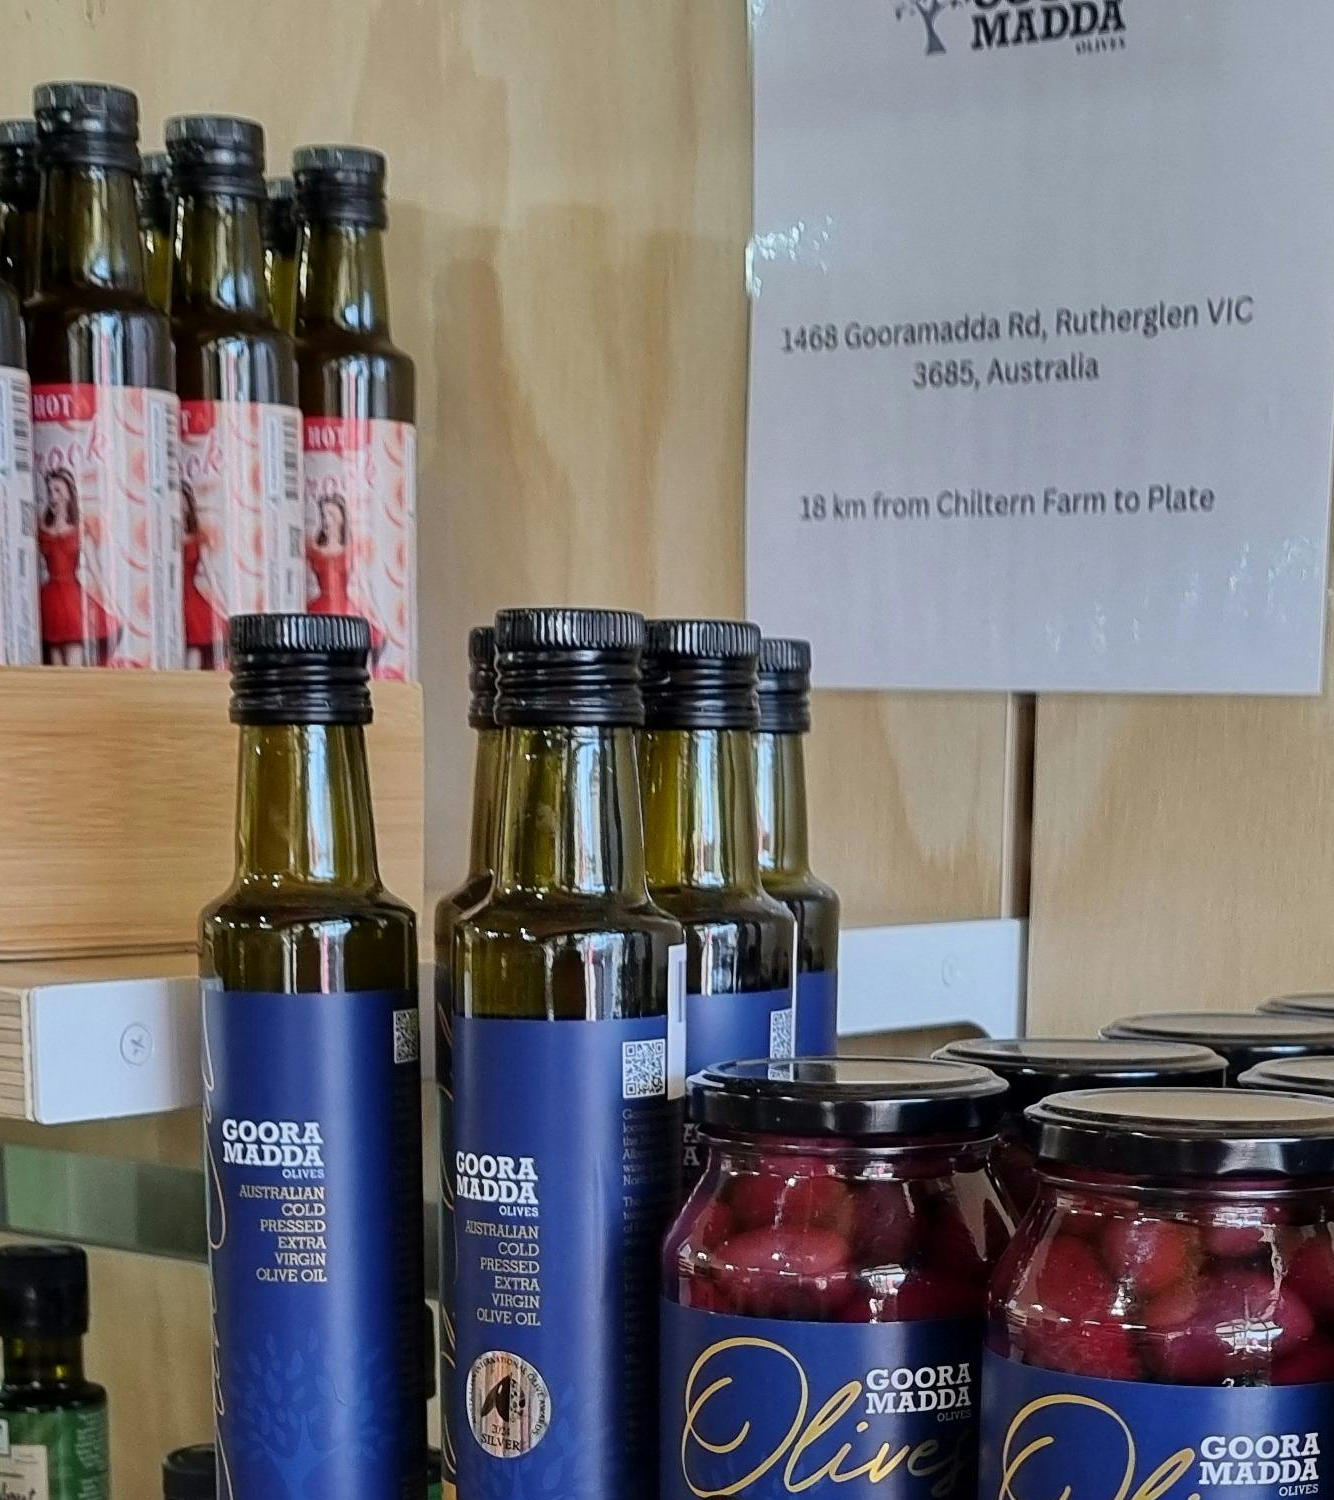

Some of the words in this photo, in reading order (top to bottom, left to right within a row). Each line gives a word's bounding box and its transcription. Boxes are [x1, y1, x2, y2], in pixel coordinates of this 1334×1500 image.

[970, 0, 1126, 50] MADDA
[780, 323, 839, 352] 1468
[844, 311, 1000, 350] Gooramadda
[1007, 308, 1048, 342] Rd,
[1055, 299, 1199, 337] Rutherglen
[1206, 295, 1255, 325] VIC
[913, 358, 980, 390] 3685,
[986, 353, 1099, 384] Australia
[33, 394, 73, 420] HOT
[307, 425, 348, 448] HOT
[799, 494, 826, 521] 18
[833, 493, 866, 519] km
[873, 491, 930, 519] from
[936, 486, 1035, 518] Chiltern
[1043, 486, 1105, 514] Farm
[1113, 488, 1141, 513] to
[1148, 483, 1214, 513] Plate
[222, 1118, 324, 1144] GOORA
[222, 1141, 324, 1167] MADDA
[281, 1167, 325, 1180] OLIVES
[456, 1151, 538, 1180] GOORA
[239, 1184, 325, 1200] AUSTRALIAN
[456, 1174, 539, 1205] MADDA
[281, 1202, 326, 1217] COLD
[498, 1204, 539, 1218] OLIVES
[260, 1218, 326, 1233] PRESSED
[465, 1219, 539, 1239] AUSTRALIAN
[278, 1235, 327, 1250] EXTRA
[498, 1241, 539, 1257] COLD
[274, 1251, 327, 1266] VIRGIN
[480, 1257, 540, 1274] PRESSED
[256, 1267, 298, 1283] OLIVE
[300, 1268, 327, 1283] OIL
[494, 1276, 540, 1291] EXTRA
[491, 1293, 540, 1308] VIRGIN
[476, 1308, 512, 1325] OLIVE
[515, 1311, 541, 1326] OIL
[865, 1363, 972, 1391] GOORA
[865, 1386, 972, 1415] MADDA
[936, 1409, 972, 1423] OLIVES
[481, 1433, 521, 1451] SILVER
[1200, 1432, 1321, 1460] GOORA
[1198, 1457, 1320, 1485] MADDA
[1278, 1483, 1319, 1498] OLIVES
